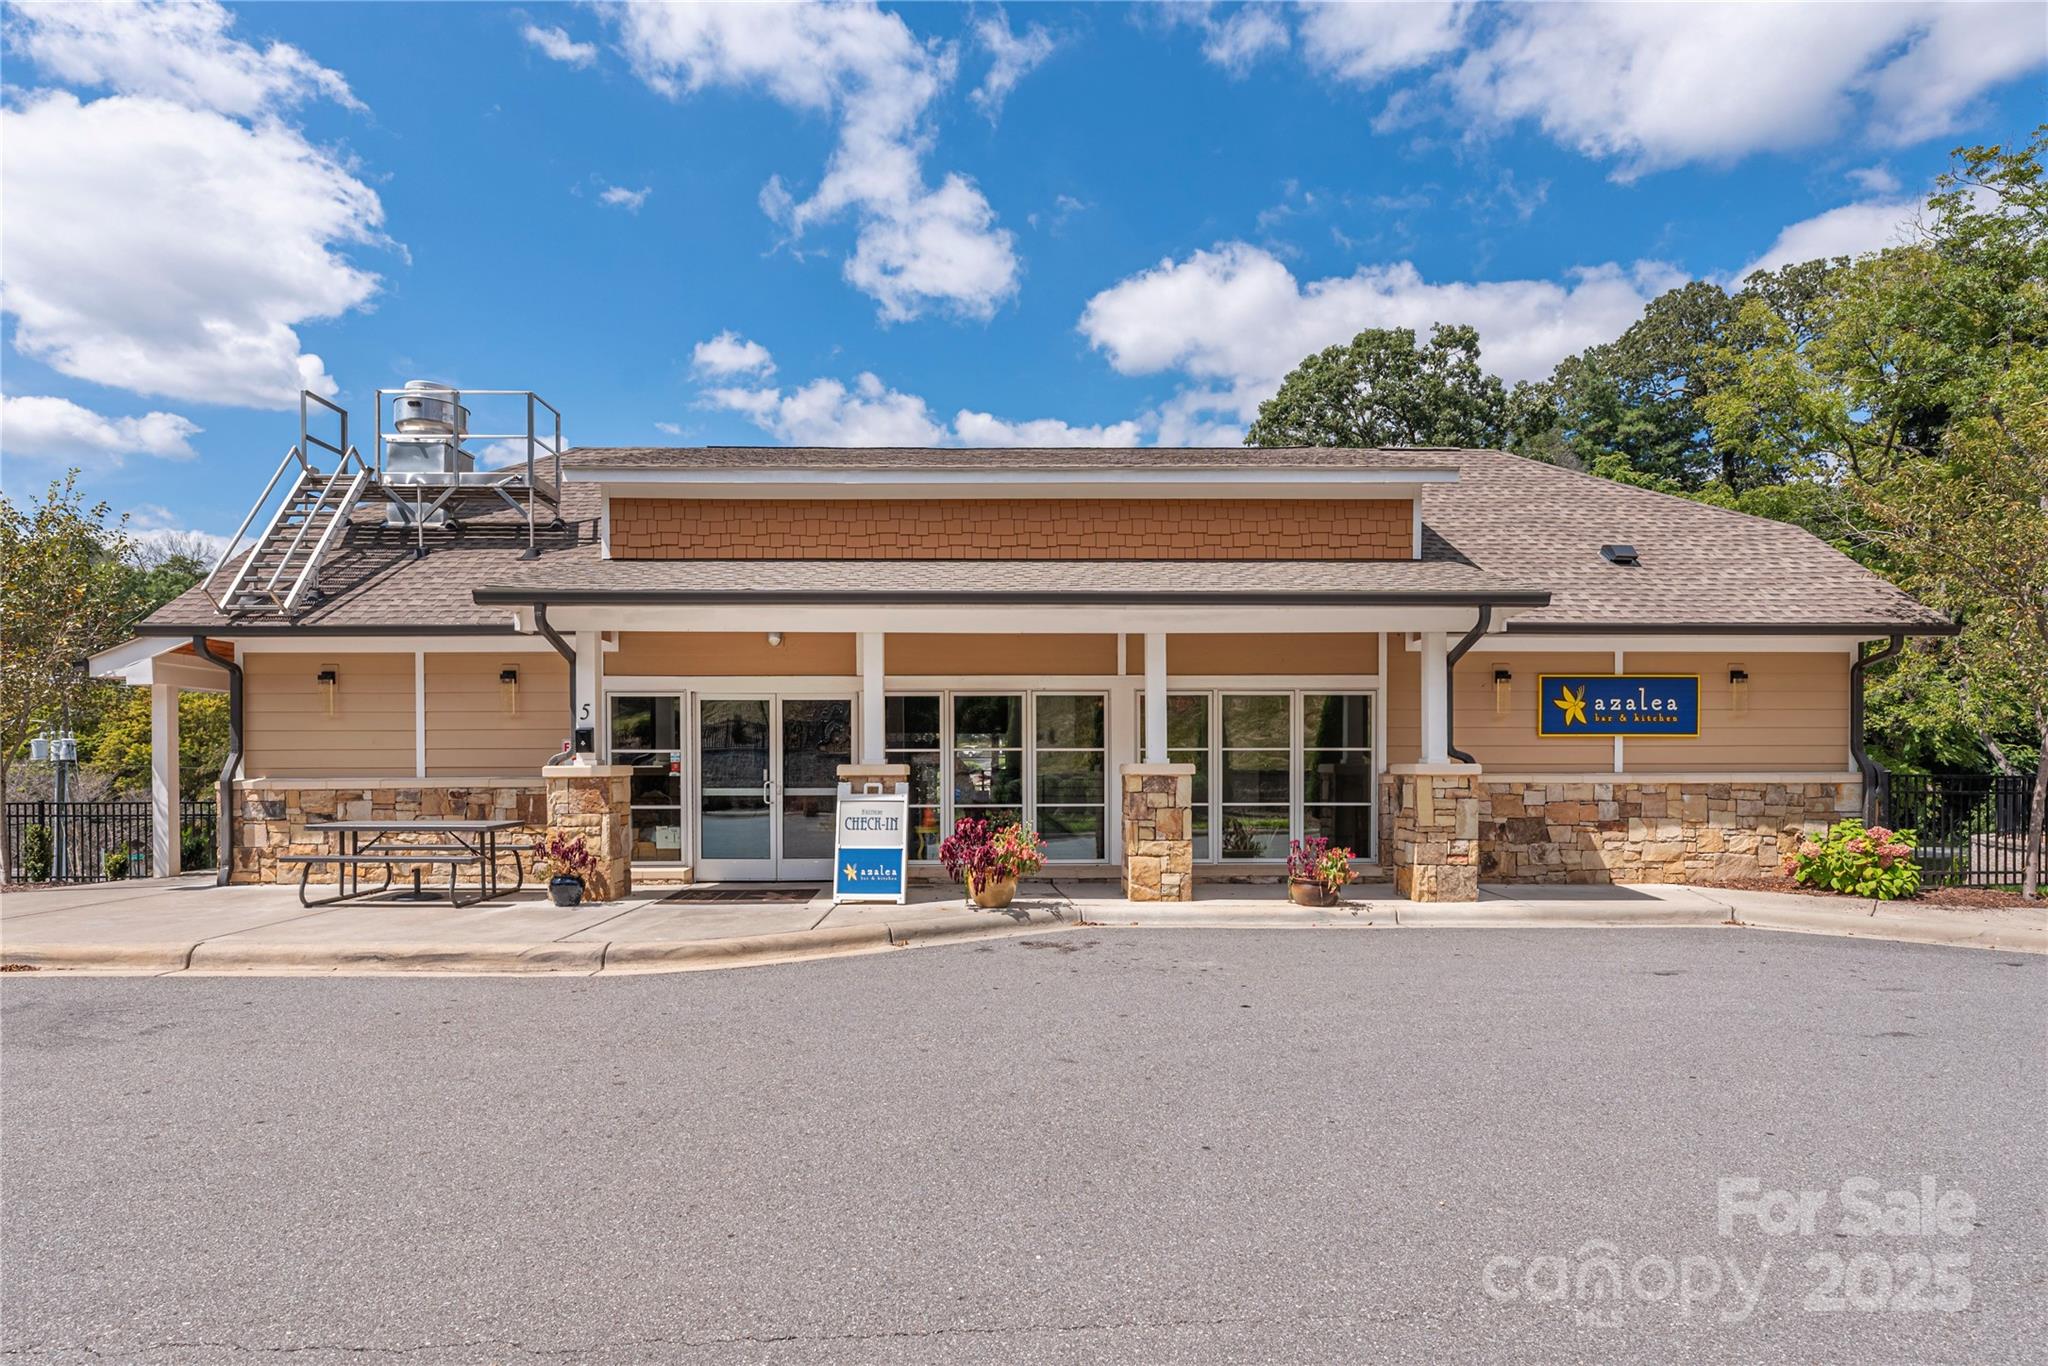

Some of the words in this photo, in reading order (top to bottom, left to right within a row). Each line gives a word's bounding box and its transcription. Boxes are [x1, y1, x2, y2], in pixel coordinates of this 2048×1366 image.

[1594, 687, 1678, 711] azalea
[580, 703, 591, 720] 5
[1594, 714, 1612, 722] bar
[1619, 714, 1627, 722] &
[1633, 713, 1678, 722] kitchen
[844, 816, 899, 831] CHECK-IN
[860, 864, 897, 876] azalea
